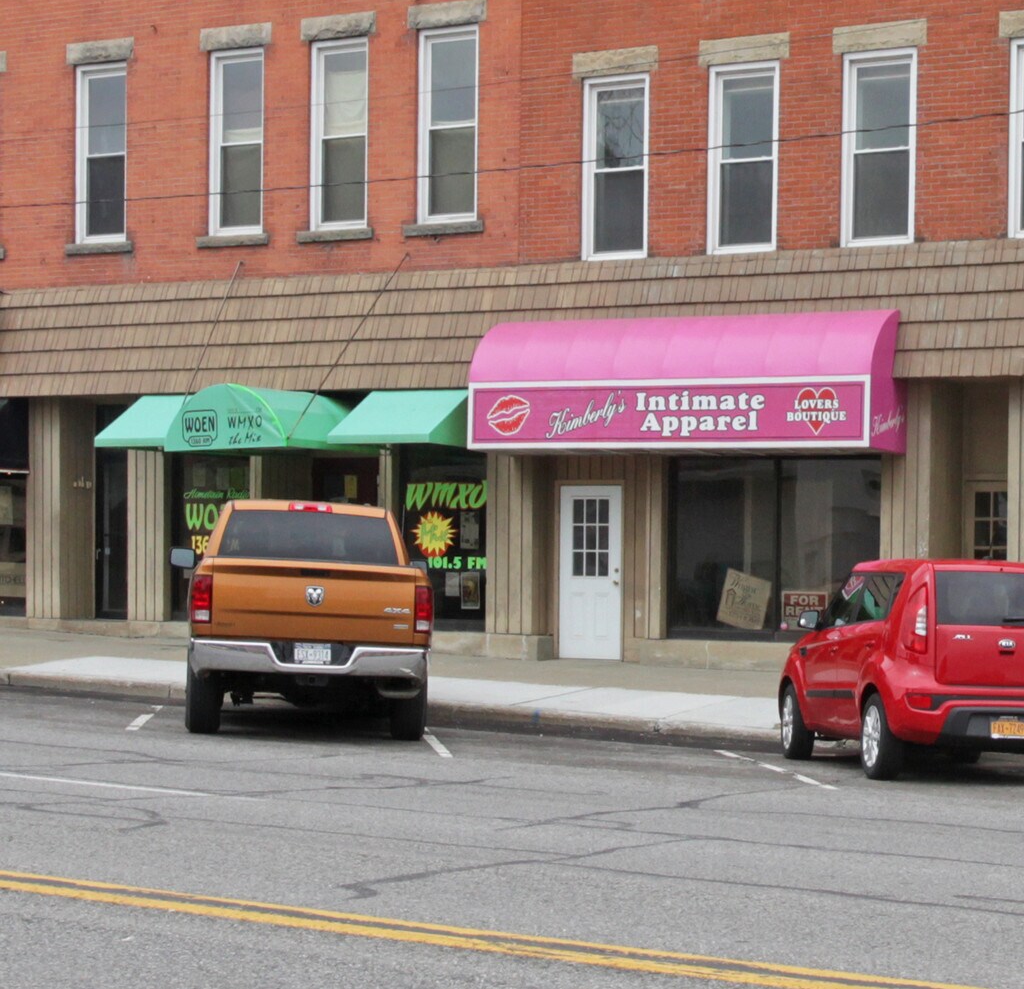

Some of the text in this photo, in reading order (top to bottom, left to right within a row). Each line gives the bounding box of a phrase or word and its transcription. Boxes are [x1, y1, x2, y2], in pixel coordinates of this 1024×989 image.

[635, 390, 765, 411] Intimate
[794, 398, 839, 410] LOVERS
[227, 415, 262, 429] WMXO
[545, 390, 626, 439] Kimberly's
[786, 411, 847, 424] BOUTIQUE
[184, 416, 215, 433] WOEN
[639, 410, 758, 437] Apparel
[185, 503, 226, 530] WO
[428, 556, 487, 570] 101.5 FM
[790, 595, 819, 606] FOR
